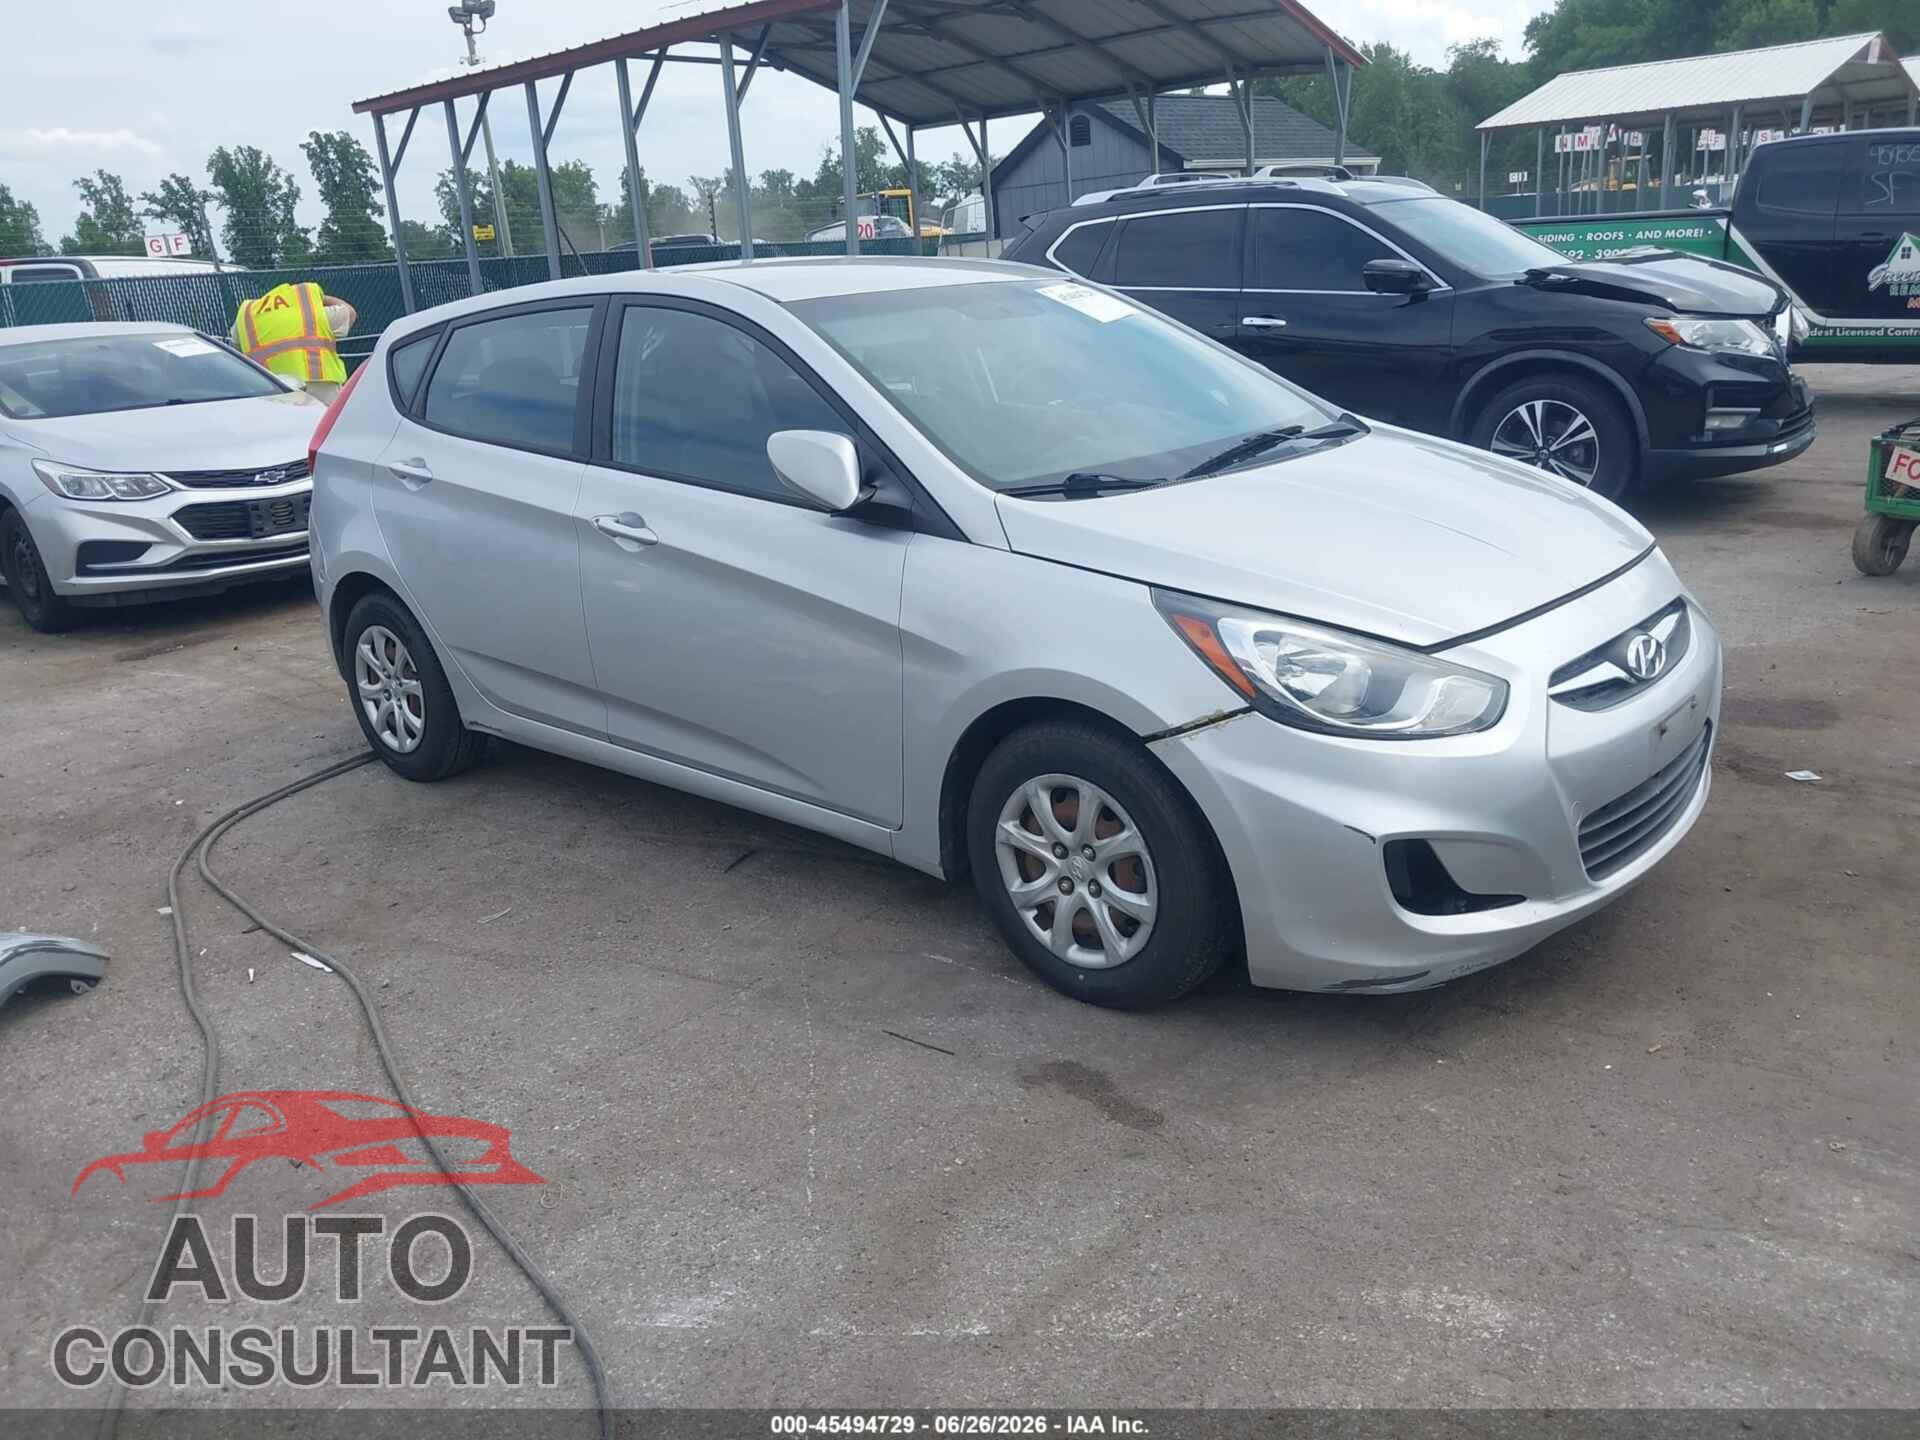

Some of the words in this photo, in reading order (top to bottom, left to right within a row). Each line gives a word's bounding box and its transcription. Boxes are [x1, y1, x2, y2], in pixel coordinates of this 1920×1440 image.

[1577, 135, 1588, 148] M
[1586, 230, 1624, 241] ROOFS
[1635, 229, 1662, 240] AND
[1664, 228, 1704, 239] MORE!
[150, 239, 162, 253] G
[174, 237, 184, 251] F
[1836, 327, 1885, 337] Licensed
